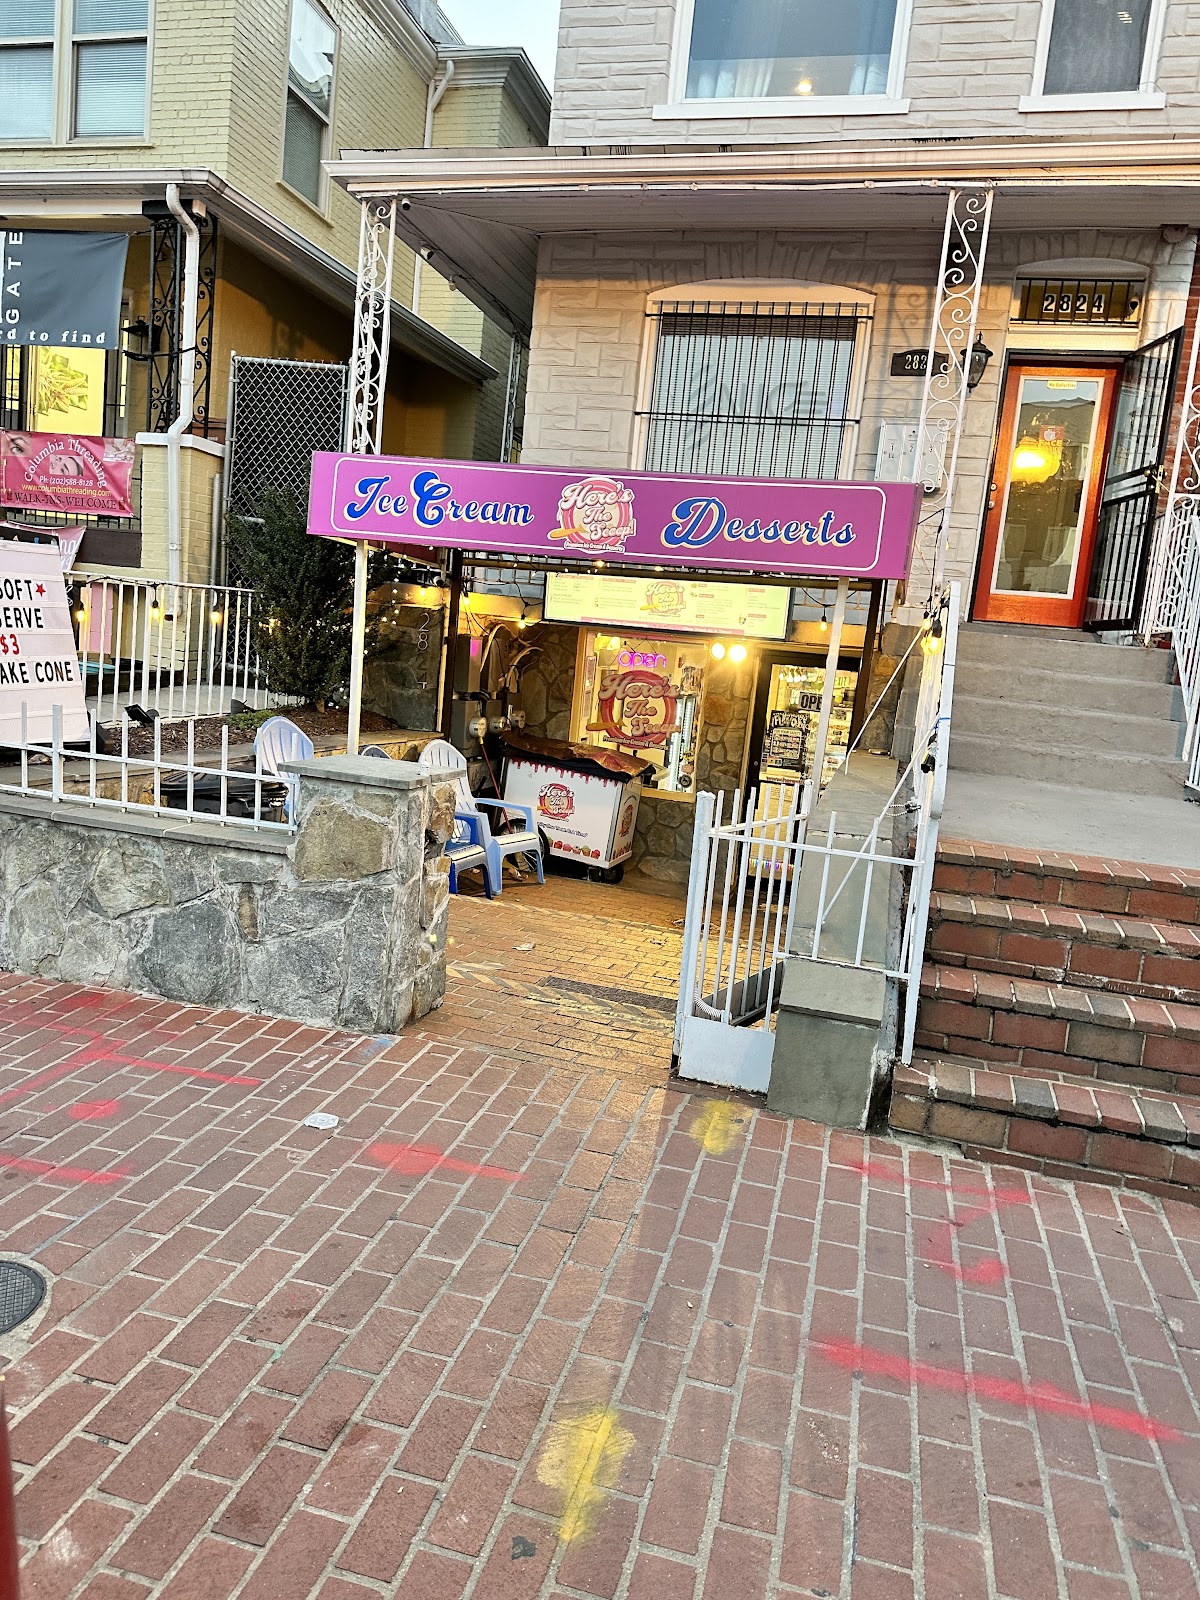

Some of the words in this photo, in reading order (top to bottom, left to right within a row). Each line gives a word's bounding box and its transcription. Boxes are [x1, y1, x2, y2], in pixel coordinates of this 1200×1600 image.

[6, 231, 23, 325] GATE
[1043, 294, 1103, 312] 2824
[29, 330, 49, 341] to
[61, 330, 106, 344] find
[905, 354, 928, 370] 282
[24, 439, 64, 482] Columbia
[68, 439, 107, 489] Threading
[22, 484, 112, 497] www.columbiathreading.com
[50, 477, 94, 487] (202)588-8128
[15, 492, 117, 510] WALK-INS-WELCOME
[344, 475, 408, 521] Ice
[410, 471, 534, 528] Cream
[560, 483, 634, 510] Here's
[583, 505, 612, 524] The
[660, 497, 856, 548] Desserts
[590, 520, 636, 541] Scoop!
[645, 582, 685, 597] Here's
[0, 607, 44, 628] ERVE
[0, 634, 20, 655] $3
[35, 661, 73, 682] CONE
[598, 674, 681, 701] Here's
[624, 699, 658, 719] The
[539, 784, 574, 797] Here's
